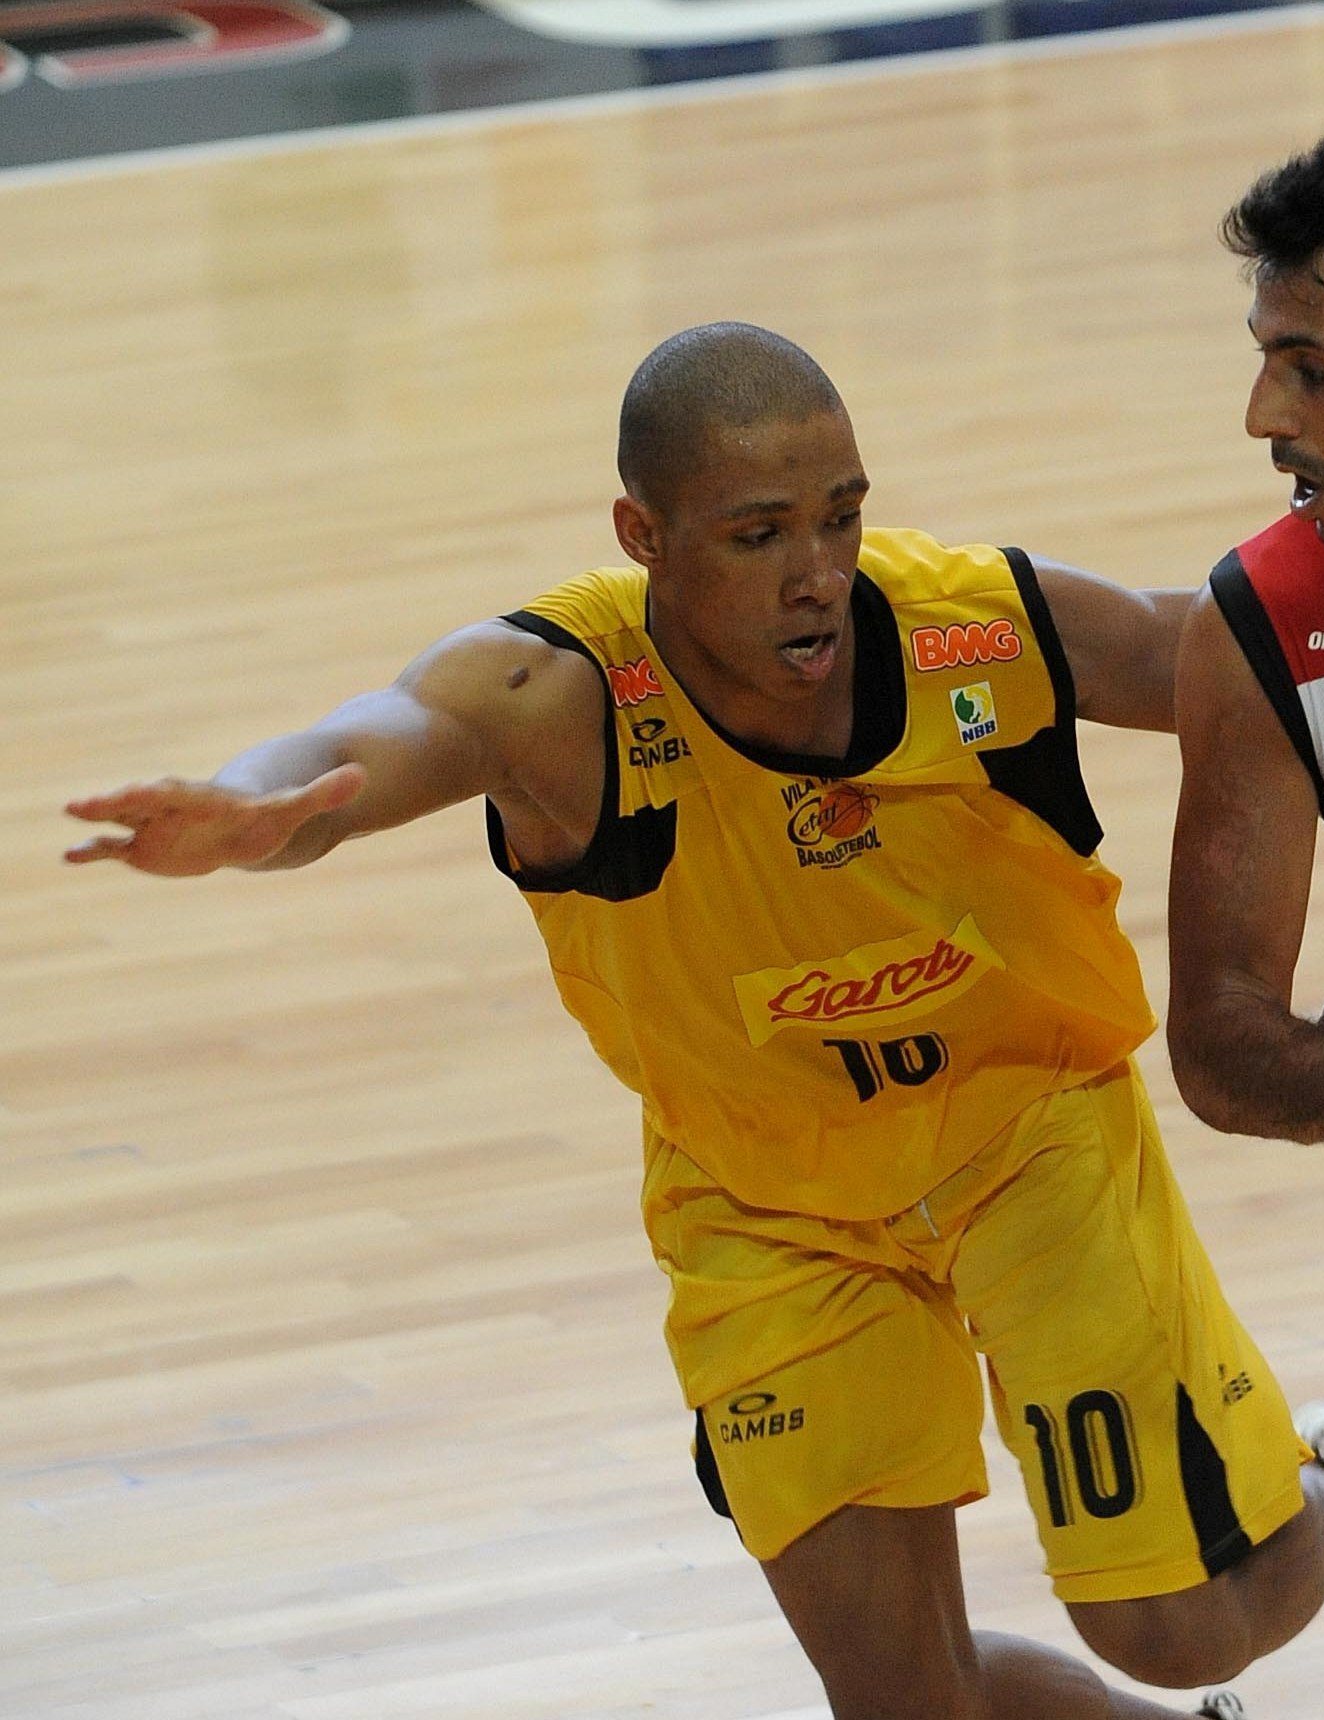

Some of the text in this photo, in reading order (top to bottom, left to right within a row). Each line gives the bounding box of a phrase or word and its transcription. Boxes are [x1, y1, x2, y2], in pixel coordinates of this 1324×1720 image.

[910, 618, 1023, 672] BMG
[962, 720, 996, 744] NBB
[822, 1031, 949, 1103] 10
[720, 1408, 805, 1444] CAMBS
[1024, 1388, 1144, 1528] 10
